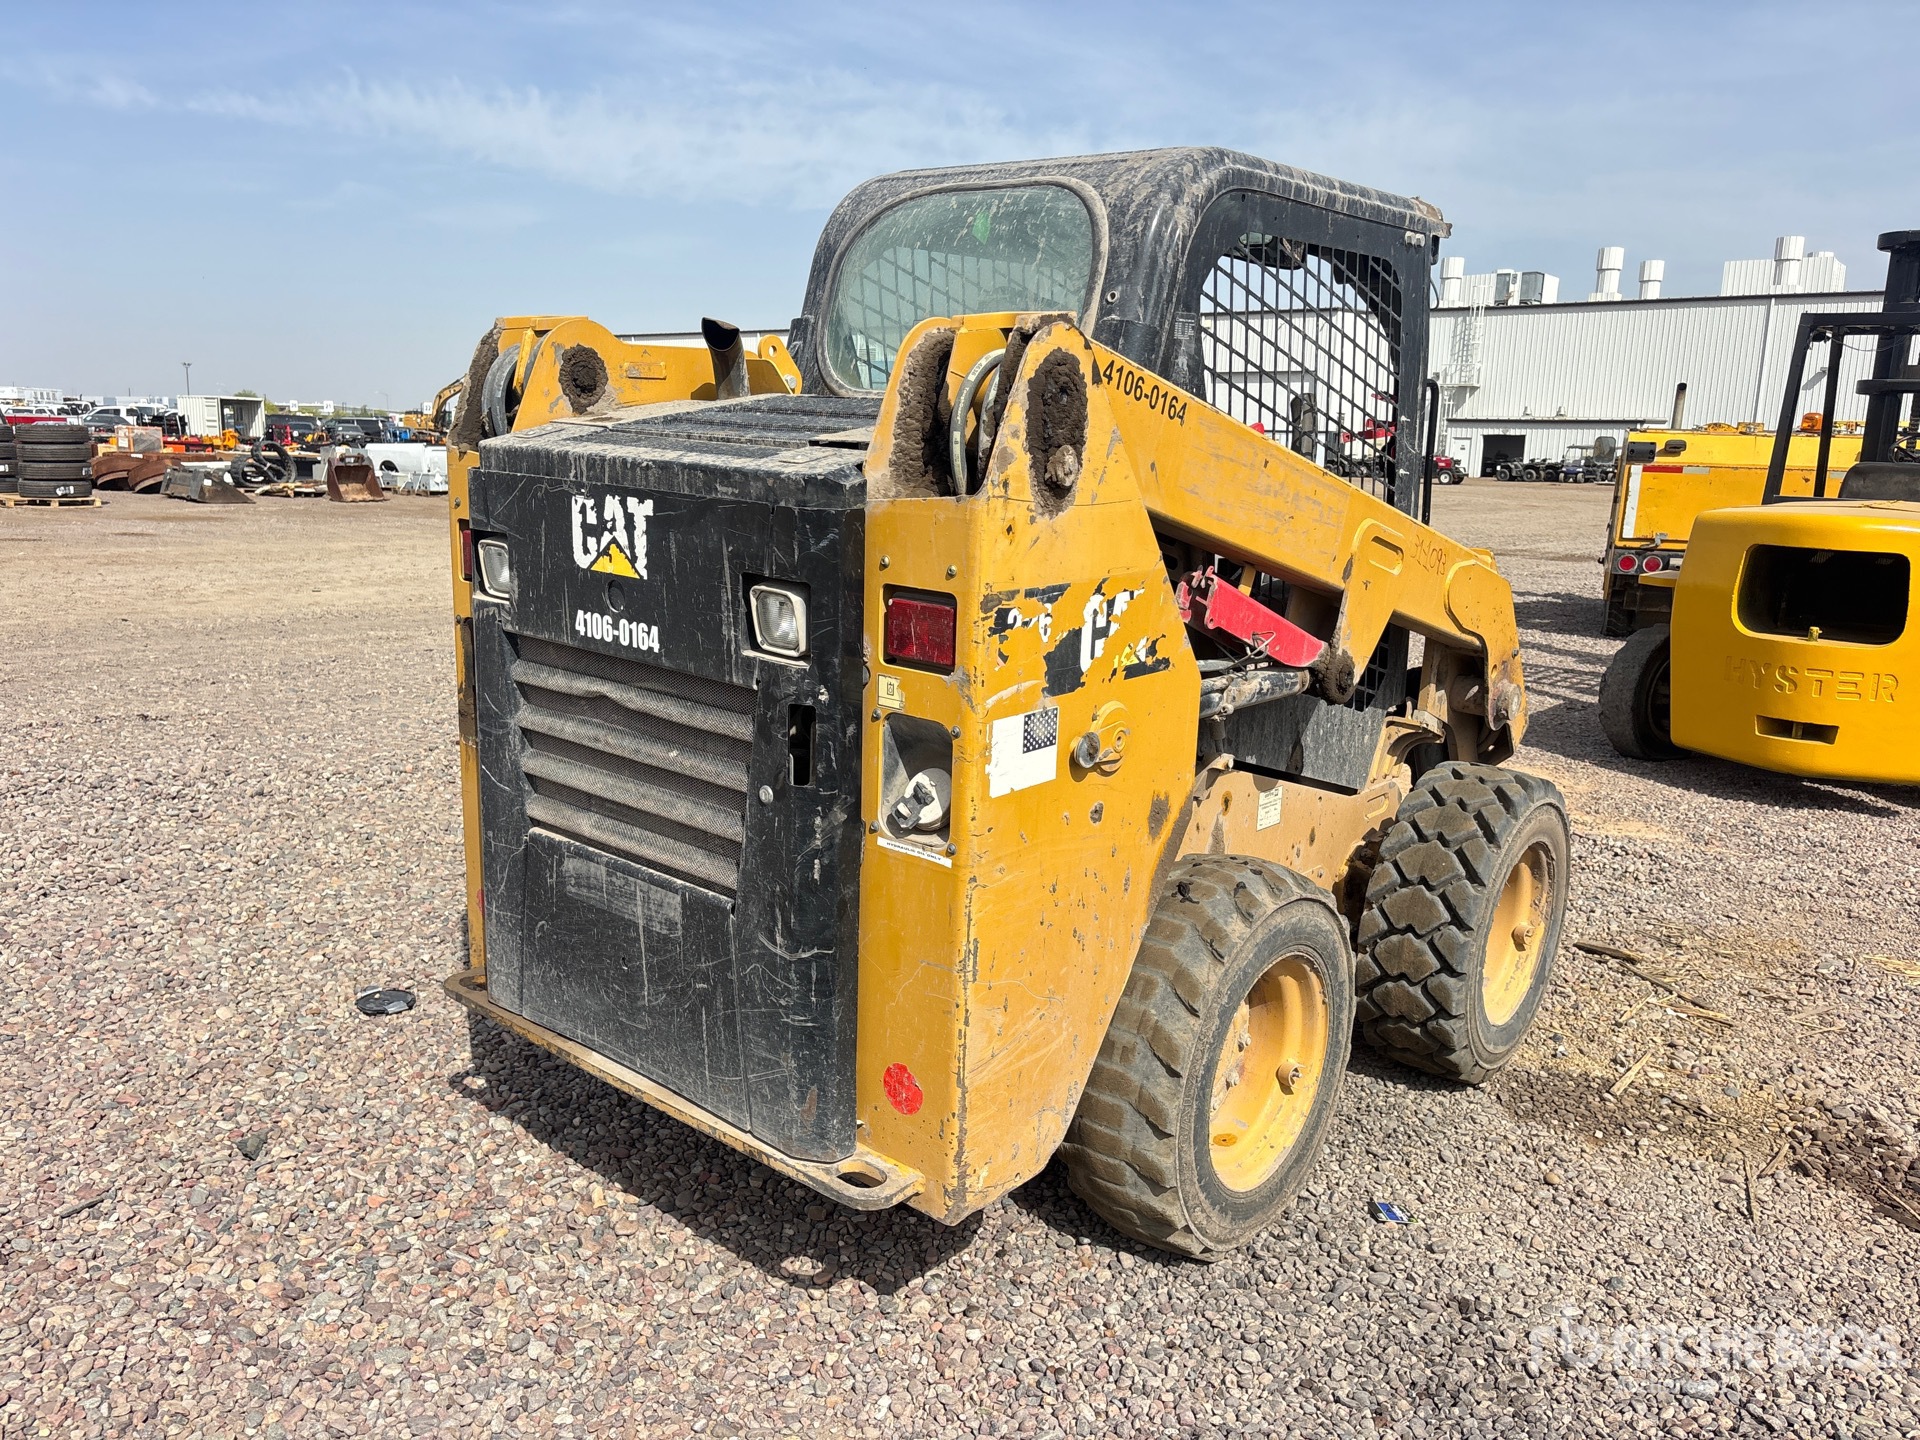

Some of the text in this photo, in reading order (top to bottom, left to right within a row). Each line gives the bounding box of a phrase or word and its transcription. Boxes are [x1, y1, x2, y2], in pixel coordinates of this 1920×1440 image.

[1102, 359, 1188, 427] 4106-0164
[571, 495, 655, 580] CAT
[574, 609, 660, 653] 4106-0164
[1723, 655, 1899, 703] HYSTER
